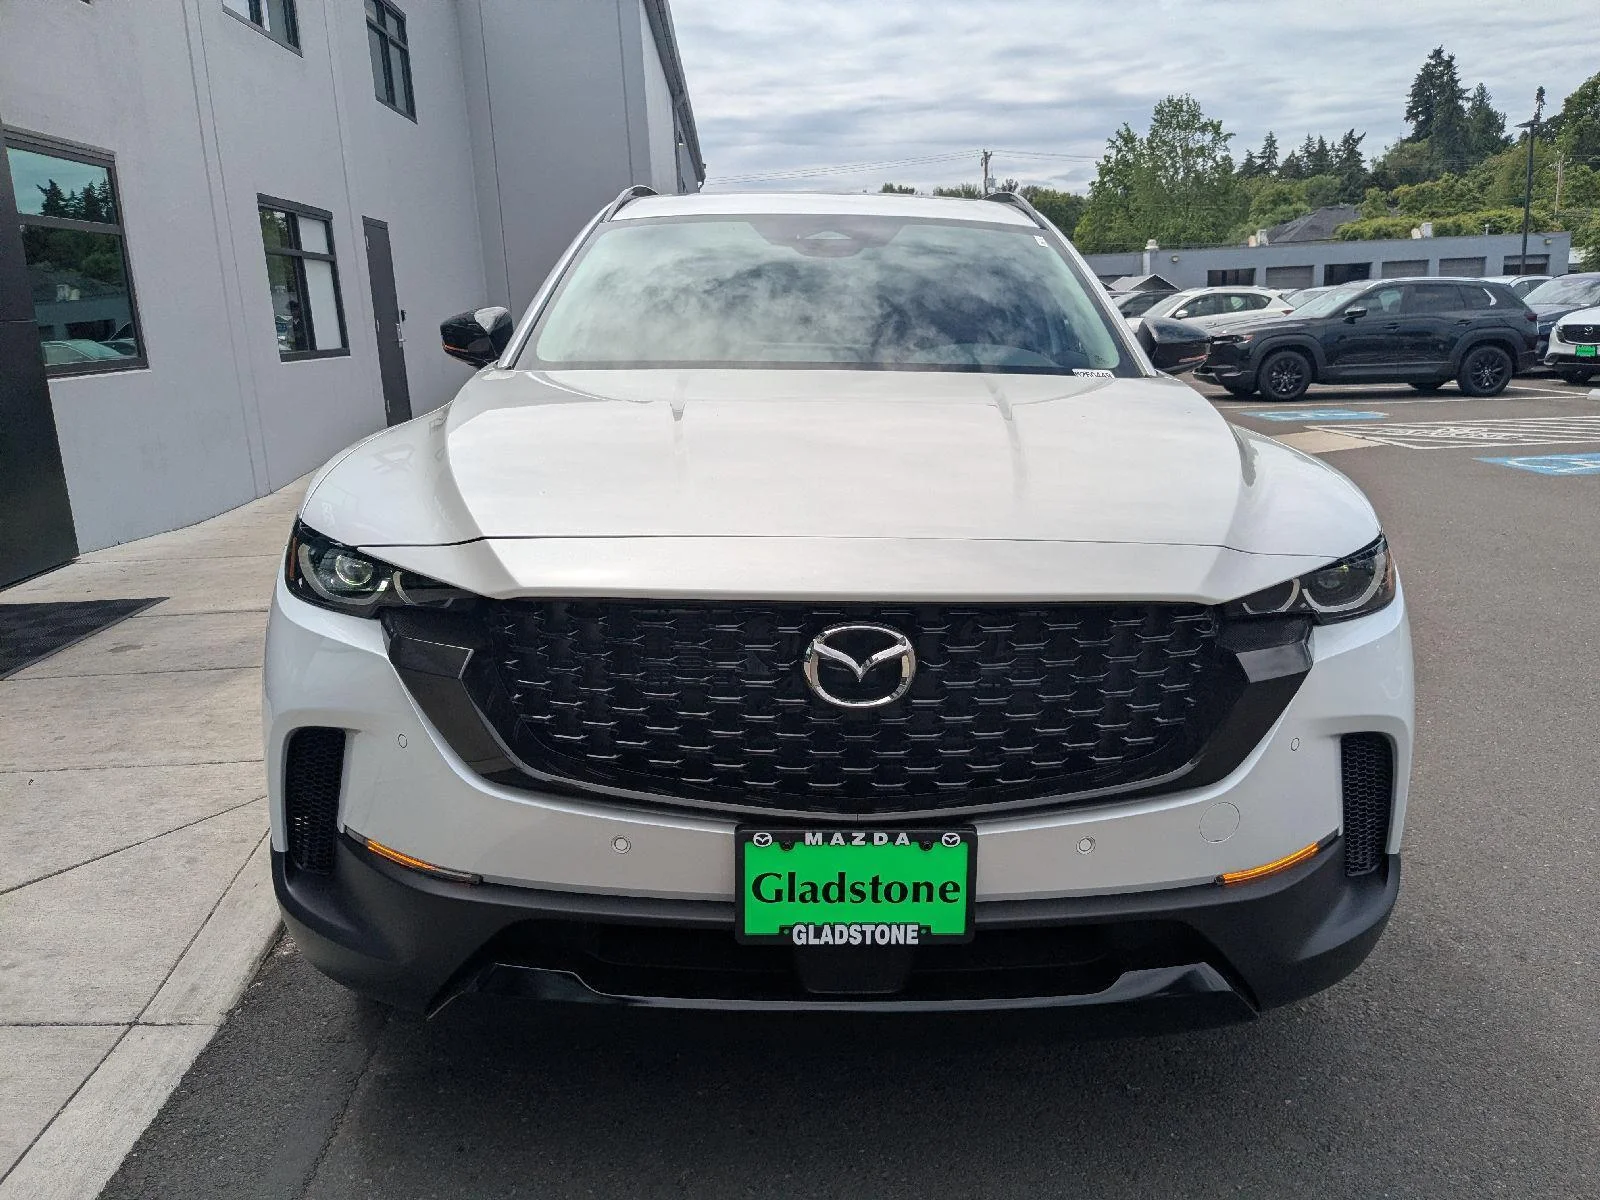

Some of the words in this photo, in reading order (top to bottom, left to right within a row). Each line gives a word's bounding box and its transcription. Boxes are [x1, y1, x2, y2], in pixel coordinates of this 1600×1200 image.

[805, 832, 911, 846] MAZDA
[751, 871, 961, 904] Gladstone
[792, 924, 919, 945] GLADSTONE
